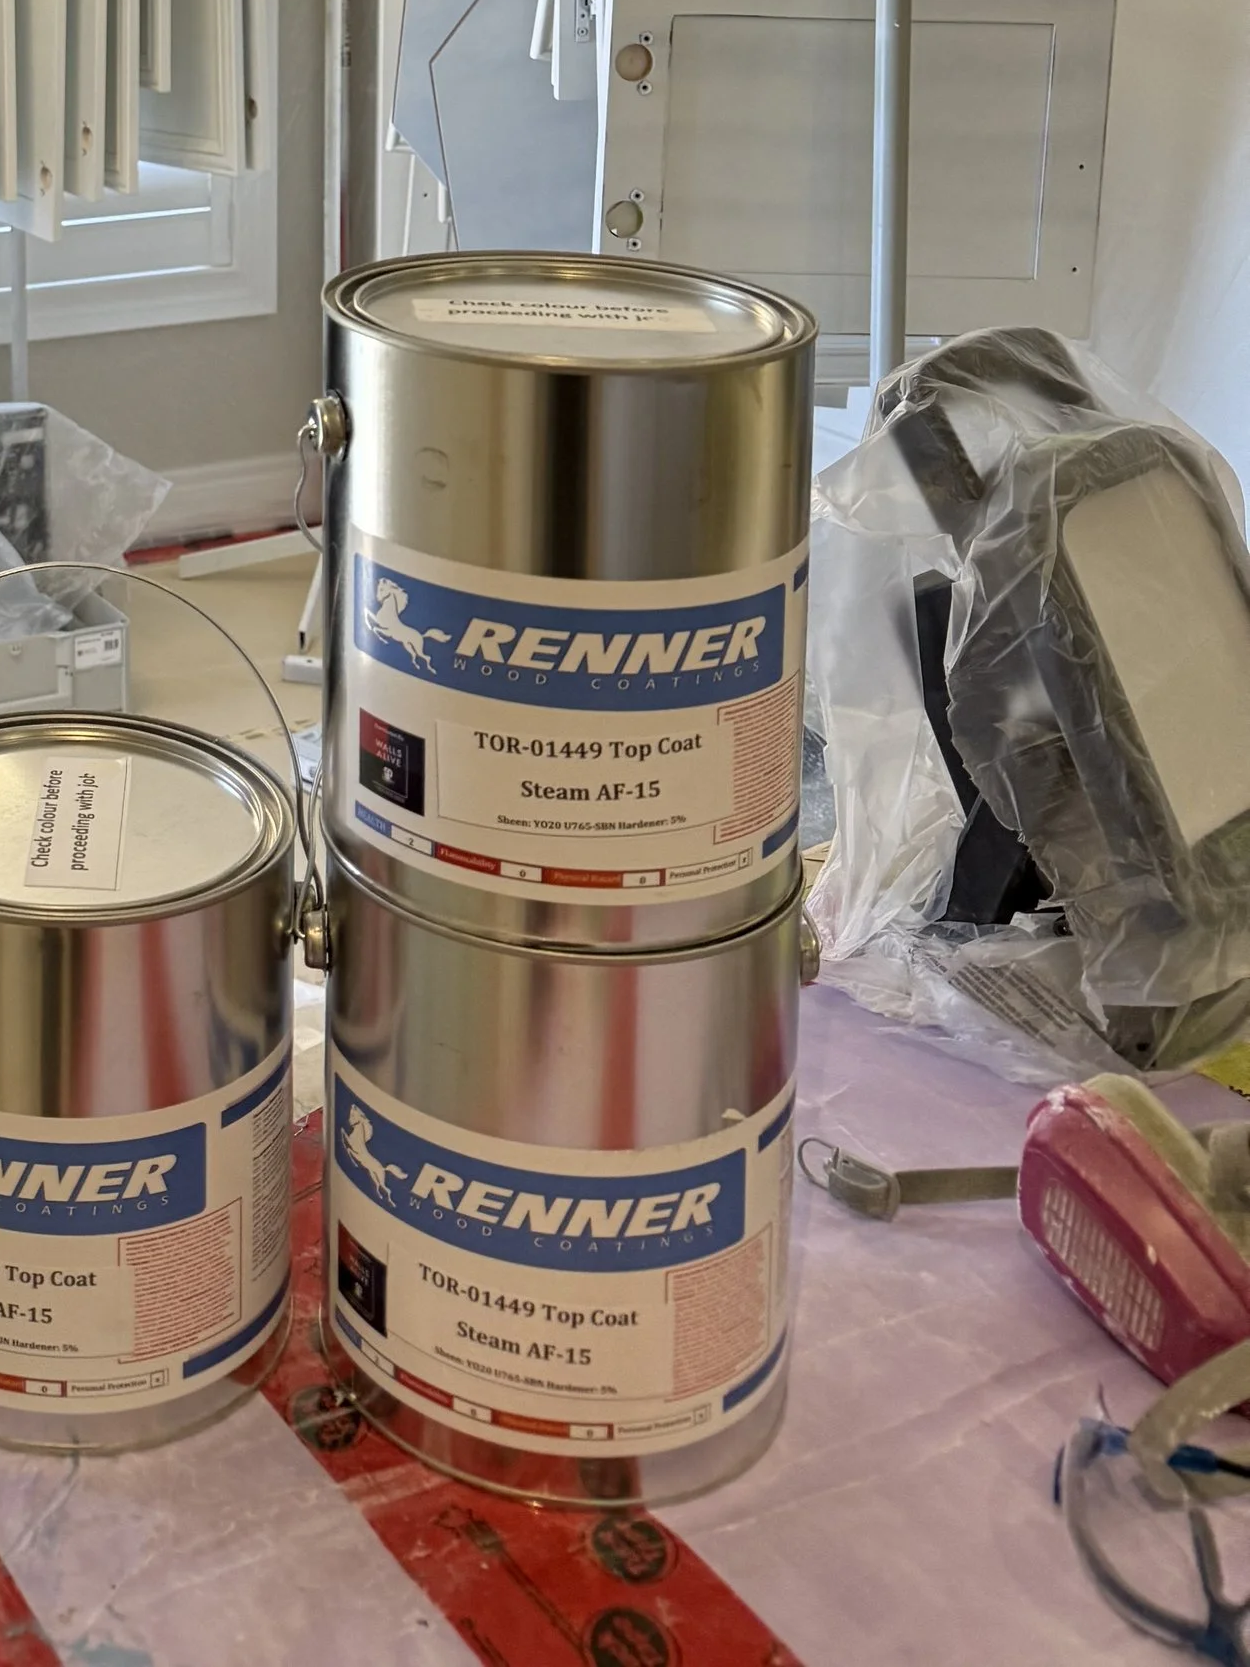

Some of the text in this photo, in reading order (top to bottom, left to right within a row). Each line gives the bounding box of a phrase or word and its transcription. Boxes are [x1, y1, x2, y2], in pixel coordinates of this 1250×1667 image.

[448, 308, 572, 319] proceeding
[577, 312, 629, 321] with
[449, 300, 669, 314] Check colour before
[455, 615, 767, 675] RENNER
[453, 658, 761, 691] WOOD COATINGS
[474, 731, 703, 761] TOR-01449 Top Coat
[74, 789, 94, 811] with
[521, 780, 661, 801] Steam AF-15
[30, 769, 63, 868] Check colour before
[497, 814, 531, 828] Sheen:
[618, 819, 669, 831] Hardener:
[670, 815, 687, 825] 5%
[71, 812, 95, 871] proceeding
[408, 836, 415, 847] 2
[410, 1162, 721, 1238] RENNER
[409, 1196, 713, 1252] WOOD COATINGS
[5, 1264, 44, 1289] Top
[50, 1271, 97, 1287] Coat
[418, 1263, 639, 1329] TOR-01449 Top Coat
[62, 1343, 79, 1352] 5%
[456, 1320, 592, 1365] Steam AF-15
